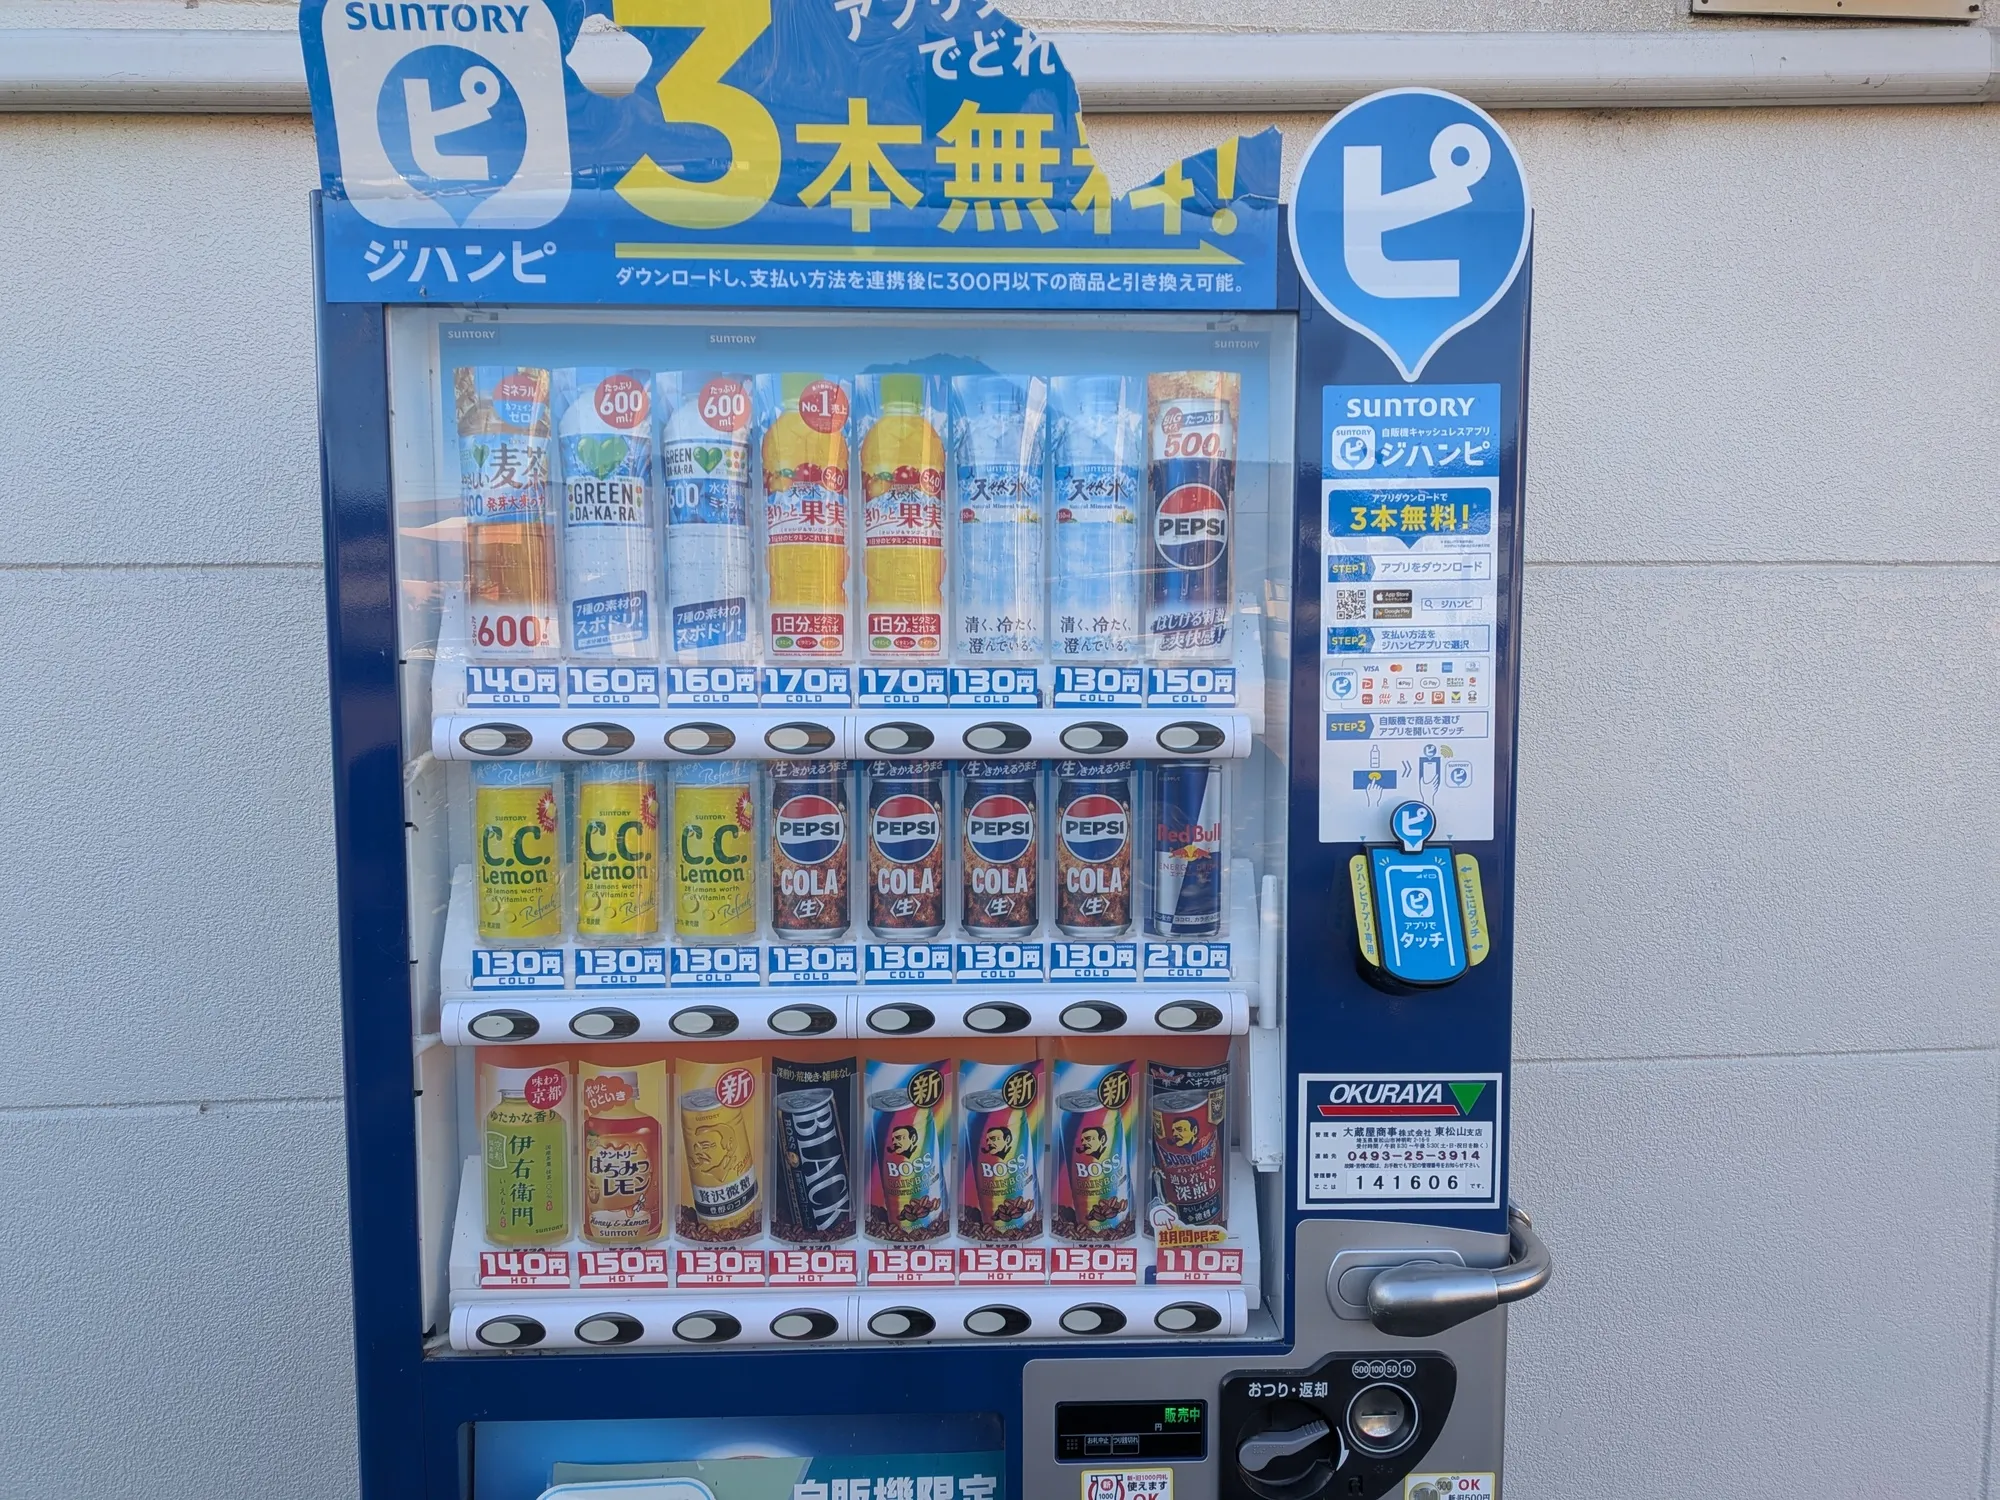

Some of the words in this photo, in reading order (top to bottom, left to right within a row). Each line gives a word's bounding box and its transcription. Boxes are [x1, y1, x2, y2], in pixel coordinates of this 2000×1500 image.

[346, 2, 530, 33] SUNTORY
[402, 66, 501, 181] ピ
[1344, 123, 1491, 298] ピ
[362, 239, 557, 284] ジハンピ
[447, 330, 496, 339] SUNTORY
[709, 335, 757, 344] SUNTORY
[1214, 340, 1261, 348] SUNTORY
[600, 391, 643, 415] 600
[703, 394, 745, 418] 600
[1346, 397, 1476, 418] SUNTORY
[1381, 427, 1491, 438] 自販機キャッシュレスアプリ
[1164, 432, 1220, 458] 500
[1381, 441, 1491, 467] ジハンピ
[574, 483, 633, 505] GREEN
[1372, 492, 1448, 502] アプリダウンロードで
[1159, 518, 1225, 536] PEPSI
[1350, 503, 1470, 532] 3本無料!
[1332, 562, 1367, 574] STEP1
[1380, 560, 1483, 574] アプリをダウンロード
[1331, 633, 1367, 646] STEP2
[1381, 630, 1436, 640] 支払い方法を
[469, 668, 556, 693] 140円
[570, 668, 655, 693] 160円
[670, 668, 755, 693] 160円
[766, 668, 848, 693] 170円
[864, 669, 945, 693] 170円
[954, 669, 1034, 693] 130円
[1060, 668, 1140, 692] 130円
[1153, 669, 1233, 693] 150円
[493, 695, 530, 703] COLD
[593, 695, 630, 703] COLD
[693, 694, 729, 702] COLD
[786, 695, 822, 703] COLD
[884, 695, 920, 703] COLD
[974, 695, 1010, 703] COLD
[1080, 694, 1115, 702] COLD
[1172, 694, 1207, 703] COLD
[1331, 720, 1366, 732] STEP3
[1379, 715, 1460, 725] 自販機で商品を選び
[1379, 726, 1465, 736] アプリを開いてタッチ
[779, 821, 840, 836] PEPSI
[876, 820, 936, 836] PEPSI
[971, 820, 1030, 836] PEPSI
[1065, 820, 1124, 835] PEPSI
[1402, 808, 1428, 836] ピ
[780, 868, 839, 896] COLA
[877, 867, 935, 896] COLA
[972, 867, 1029, 895] COLA
[1066, 867, 1123, 895] COLA
[1356, 863, 1375, 955] ジハンピアプリ専用
[1463, 879, 1481, 939] ここにタッチ
[1404, 921, 1437, 930] アプリで
[1400, 932, 1445, 949] タッチ
[478, 951, 561, 975] 130円
[581, 950, 663, 973] 130円
[676, 948, 757, 972] 130円
[773, 948, 854, 971] 130円
[870, 946, 949, 969] 130円
[962, 945, 1040, 969] 130円
[1055, 945, 1134, 968] 130円
[1149, 945, 1229, 968] 210円
[498, 976, 535, 985] COLD
[601, 975, 637, 983] COLD
[696, 973, 732, 981] COLD
[793, 972, 829, 981] COLD
[889, 970, 925, 979] COLD
[980, 970, 1016, 978] COLD
[1074, 969, 1110, 977] COLD
[1168, 968, 1203, 977] COLD
[531, 1074, 559, 1087] 味わう
[720, 1070, 752, 1105] 新
[913, 1071, 940, 1105] 新
[1007, 1072, 1034, 1107] 新
[1103, 1072, 1129, 1106] 新
[531, 1086, 562, 1104] 京都
[1329, 1083, 1443, 1104] OKURAYA
[490, 1110, 557, 1124] ゆたかな香り
[599, 1150, 638, 1160] サントリー
[886, 1153, 933, 1177] BOSS
[1347, 1150, 1481, 1161] 0493-25-3914
[589, 1156, 650, 1178] はちみつ
[792, 1102, 850, 1231] BLACK
[980, 1153, 1027, 1178] BOSS
[1076, 1153, 1121, 1178] BOSS
[508, 1135, 536, 1228] 伊右衛門
[603, 1177, 650, 1197] レモン
[1356, 1175, 1459, 1190] 141606
[599, 1229, 639, 1237] SUNTORY
[1158, 1229, 1220, 1247] 期間限定
[483, 1253, 567, 1275] 140円
[581, 1251, 663, 1274] 150円
[681, 1251, 762, 1273] 130円
[772, 1251, 853, 1273] 130円
[872, 1251, 952, 1272] 130円
[963, 1250, 1043, 1271] 130円
[1055, 1250, 1134, 1271] 130円
[1162, 1251, 1240, 1272] 110円
[510, 1276, 538, 1284] HOT
[608, 1275, 635, 1283] HOT
[798, 1274, 825, 1282] HOT
[897, 1273, 923, 1281] HOT
[987, 1272, 1014, 1280] HOT
[1078, 1272, 1105, 1280] HOT
[1184, 1273, 1210, 1281] HOT
[1354, 1365, 1369, 1374] 500
[1370, 1365, 1384, 1373] 100
[1386, 1365, 1398, 1373] 50
[1402, 1364, 1412, 1373] 10
[1248, 1381, 1328, 1398] おつり・返却
[1164, 1407, 1201, 1423] 販売中
[1127, 1481, 1168, 1492] 使えます
[1458, 1479, 1481, 1491] OK
